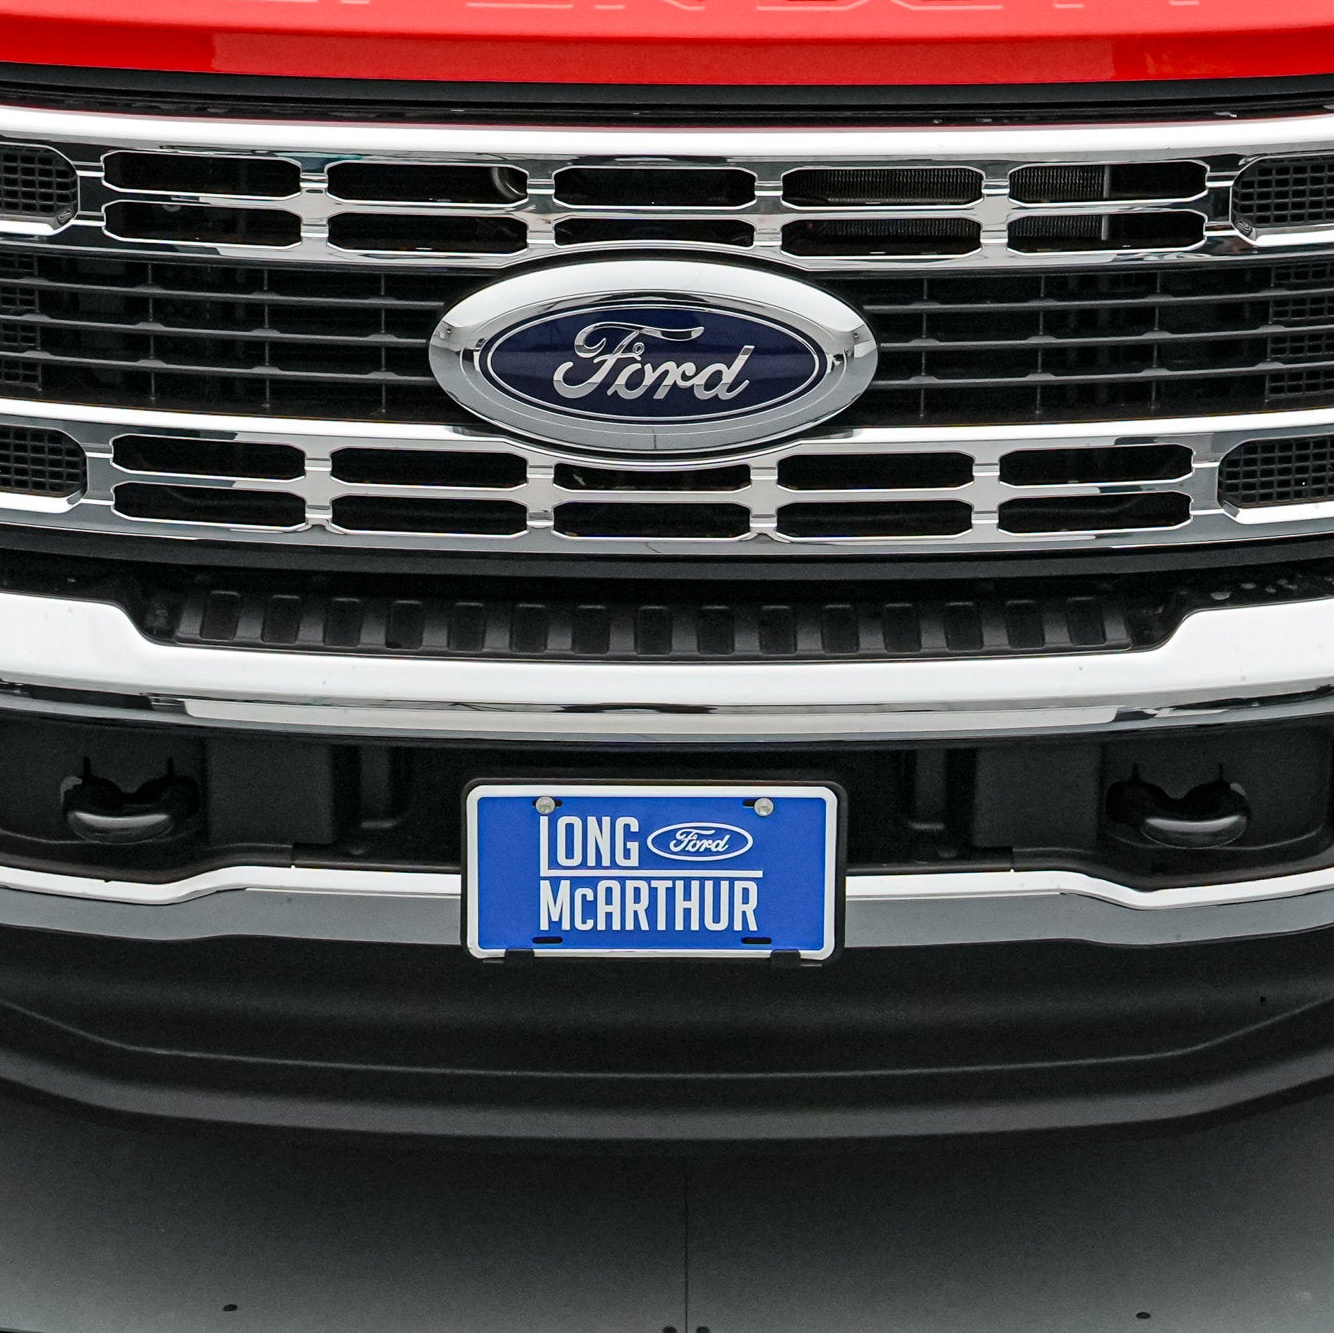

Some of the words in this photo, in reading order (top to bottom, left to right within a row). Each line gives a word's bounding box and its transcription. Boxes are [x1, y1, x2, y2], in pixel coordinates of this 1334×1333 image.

[553, 321, 755, 400] Ford
[540, 815, 639, 874] LONG
[668, 827, 732, 854] Ford
[540, 879, 759, 932] McARTHUR
